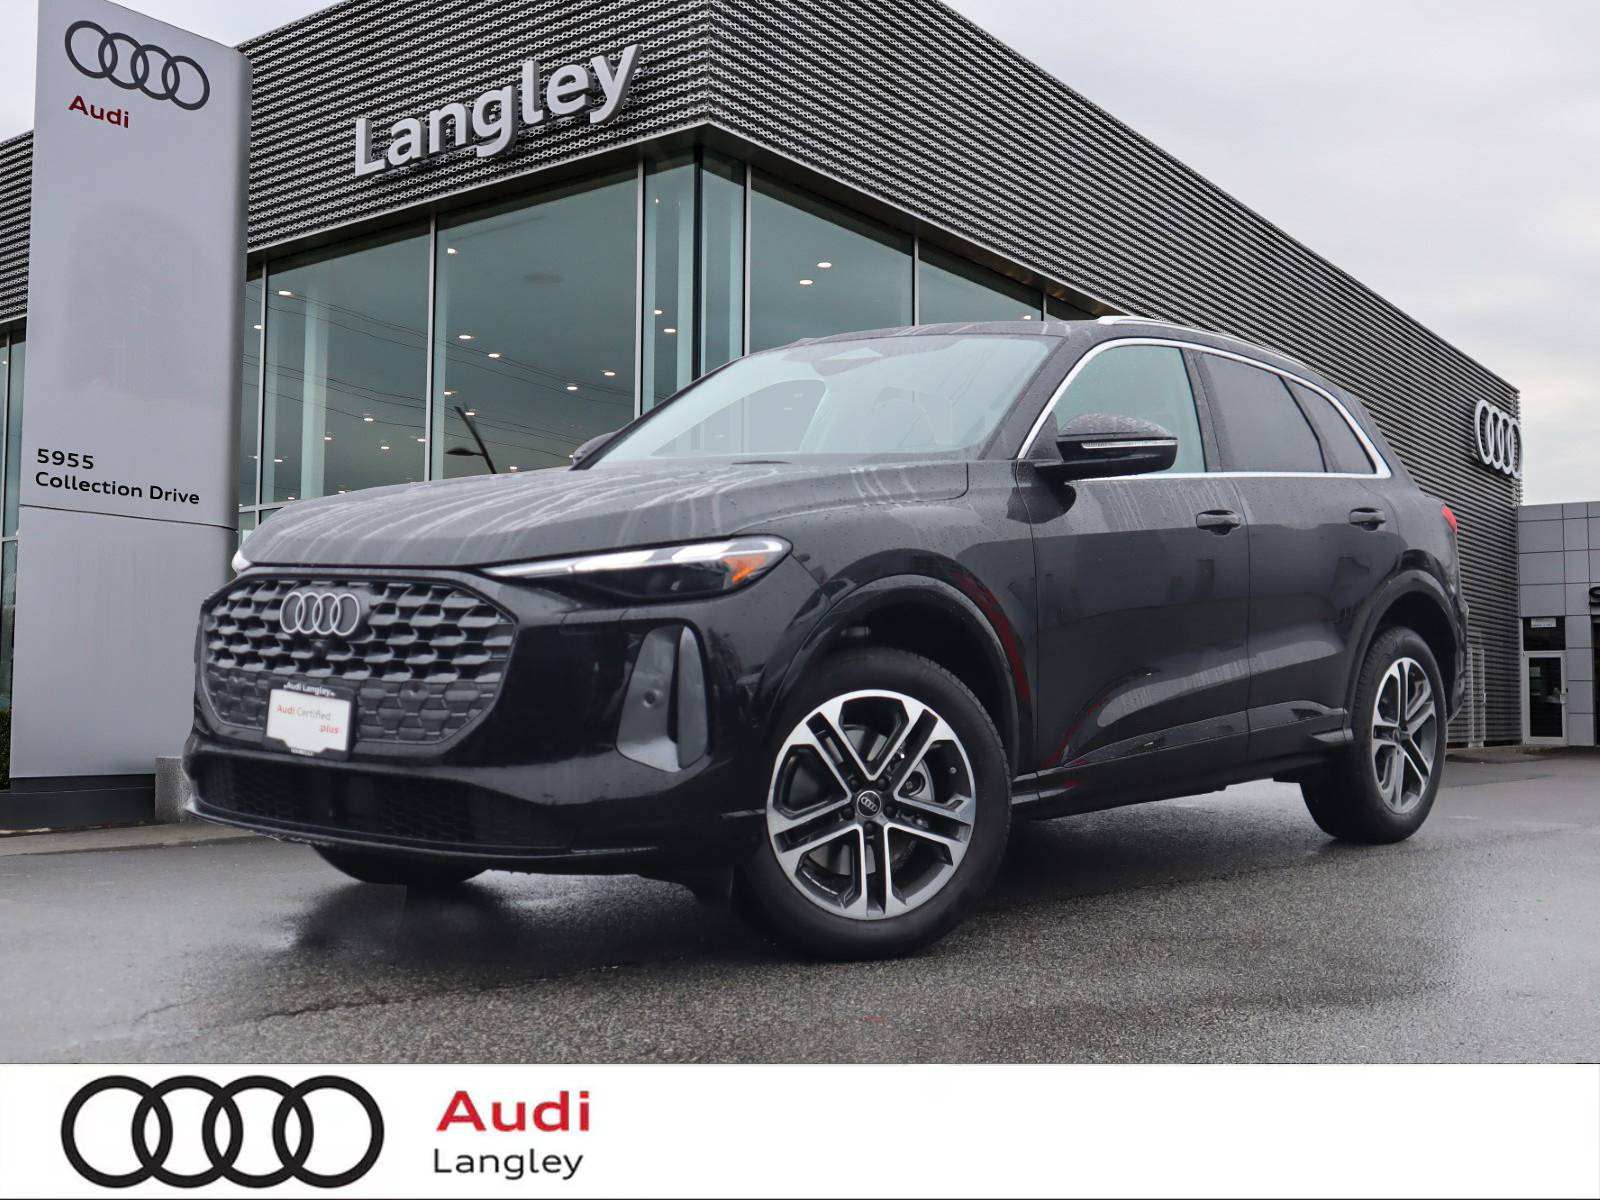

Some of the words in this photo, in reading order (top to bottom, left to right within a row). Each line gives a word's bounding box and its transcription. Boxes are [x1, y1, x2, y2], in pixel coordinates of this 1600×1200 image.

[68, 95, 129, 128] Audi
[354, 44, 643, 177] Langley
[37, 448, 94, 470] 5955
[35, 471, 143, 498] Collection
[149, 485, 200, 505] Drive
[286, 681, 302, 691] Audi
[302, 683, 331, 696] Langley
[277, 704, 295, 715] Audi
[296, 707, 331, 720] Certified
